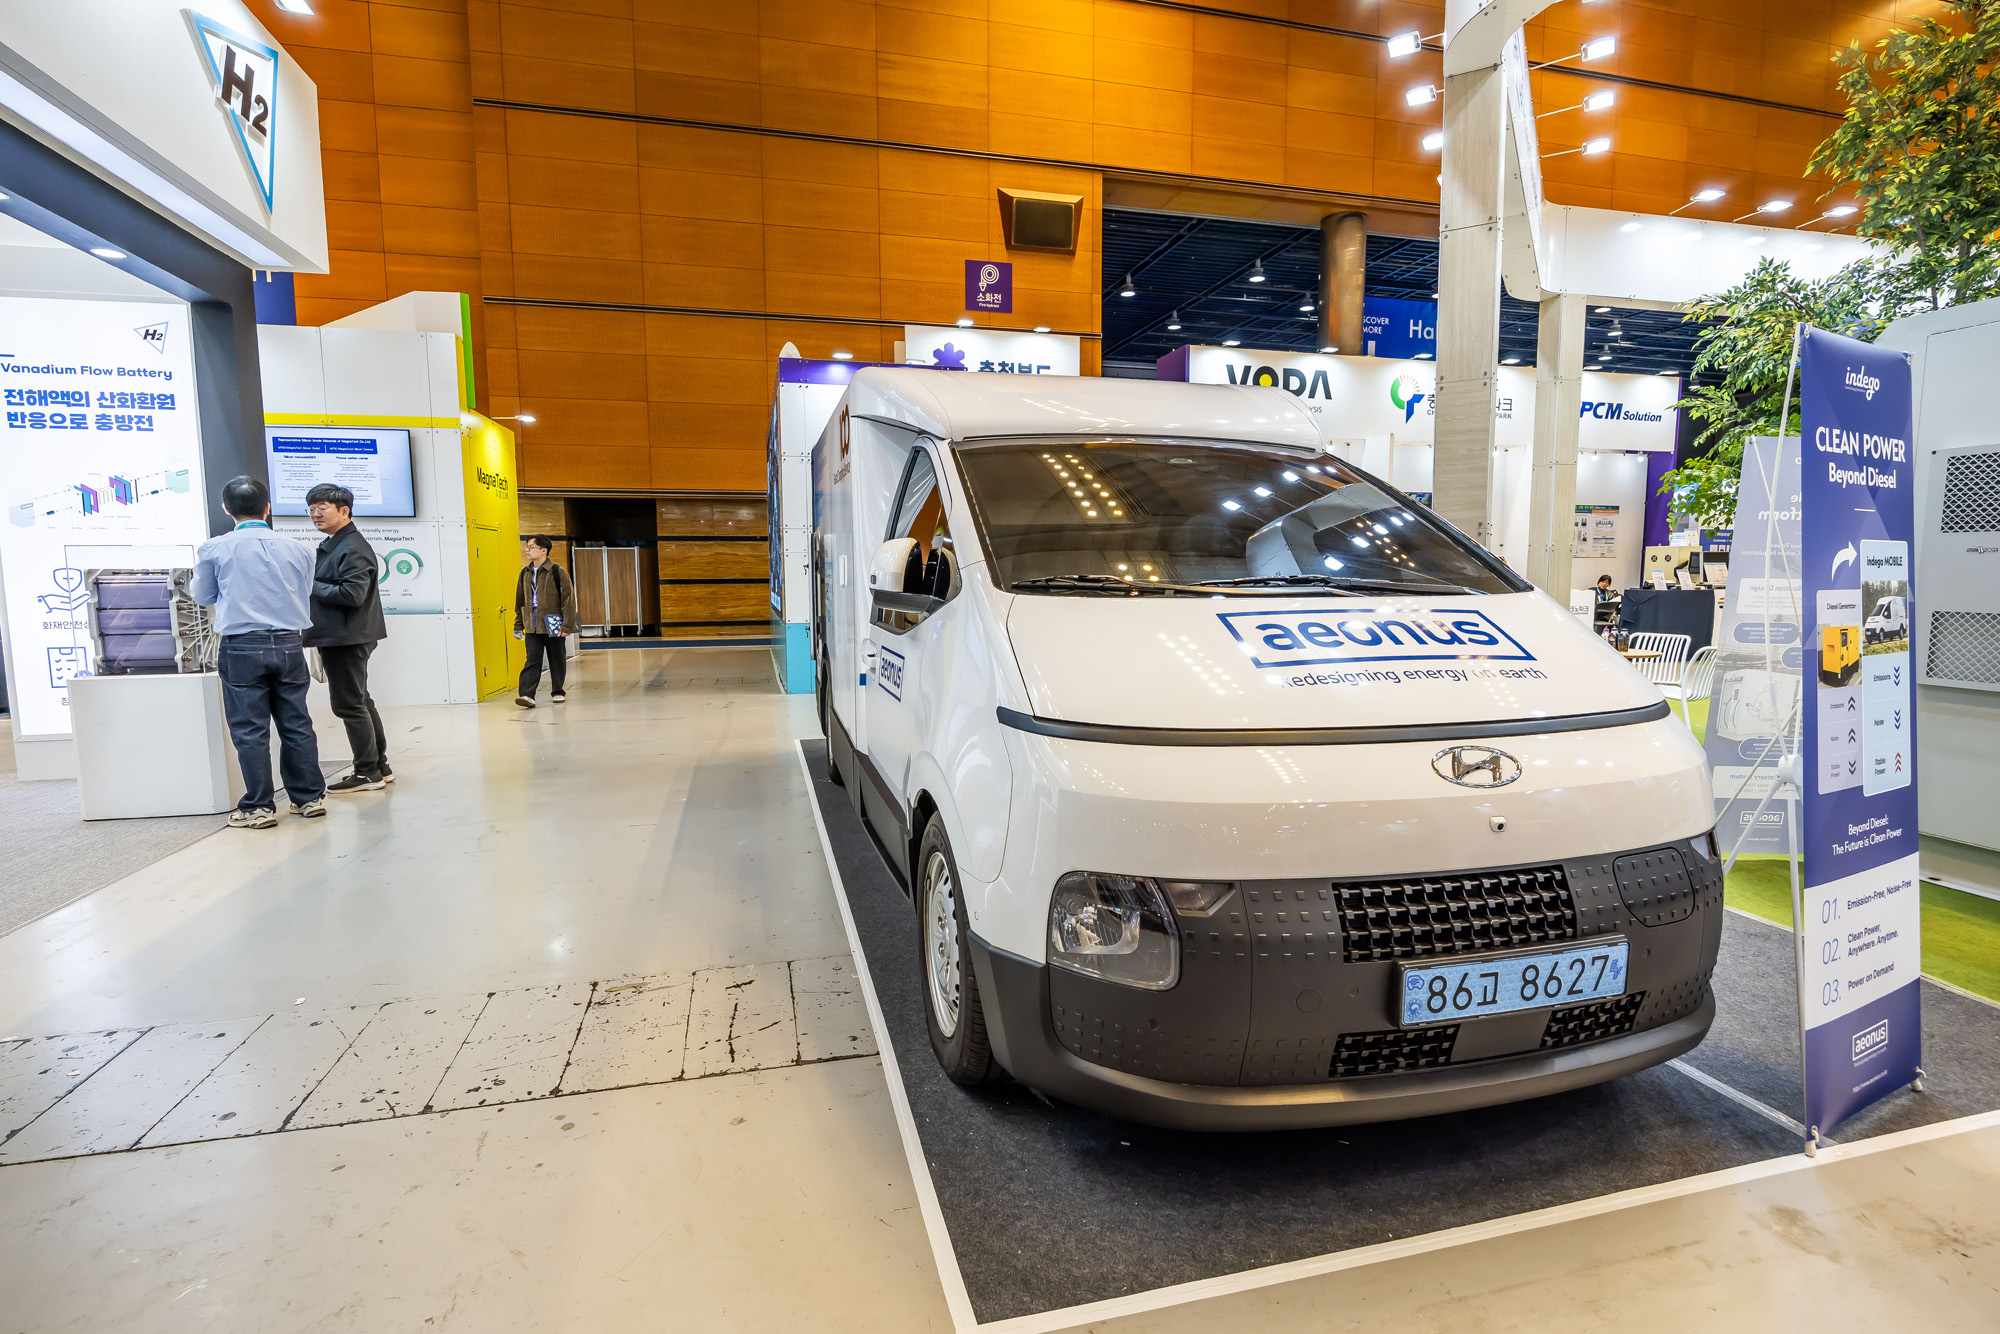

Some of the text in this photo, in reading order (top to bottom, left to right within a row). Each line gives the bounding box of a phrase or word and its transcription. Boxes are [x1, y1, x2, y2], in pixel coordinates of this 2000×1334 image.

[977, 292, 1001, 303] 소화전
[143, 329, 164, 341] H2
[1410, 319, 1434, 340] Ha
[1, 363, 173, 381] Vanadium Flow Battery
[1226, 364, 1333, 400] VODA
[1845, 365, 1880, 401] indego
[4, 389, 176, 410] 전해액의 산화환원
[7, 411, 154, 432] 반응으로 충방전
[1580, 401, 1662, 422] PCM Solution
[1815, 426, 1906, 463] CLEAN POWER
[477, 466, 508, 491] MagnaTech
[1829, 461, 1896, 488] Beyond Diesel
[1867, 556, 1903, 568] indego MOBILE
[1826, 602, 1857, 610] Diesel Generator
[1254, 619, 1500, 651] aeonus
[881, 657, 902, 689] aeonus
[1403, 668, 1467, 683] energy
[1473, 669, 1498, 680] on
[1500, 667, 1549, 679] earth
[1874, 674, 1891, 682] Emissions
[1874, 719, 1885, 727] Noise
[1874, 758, 1886, 766] Stable
[1875, 768, 1886, 776] Power
[1848, 814, 1889, 836] Beyond Diesel:
[1832, 828, 1903, 856] The Future is Clean Power
[1821, 879, 1912, 924] 01. Emission-Free, Noise-Free
[1822, 924, 1882, 965] 02. Clean Power,
[1876, 930, 1899, 945] Anytime.
[1427, 971, 1499, 1014] 86고
[1520, 954, 1610, 1002] 8627
[1822, 961, 1895, 1006] 03. Power on Demand
[1855, 1026, 1886, 1053] aeonus
